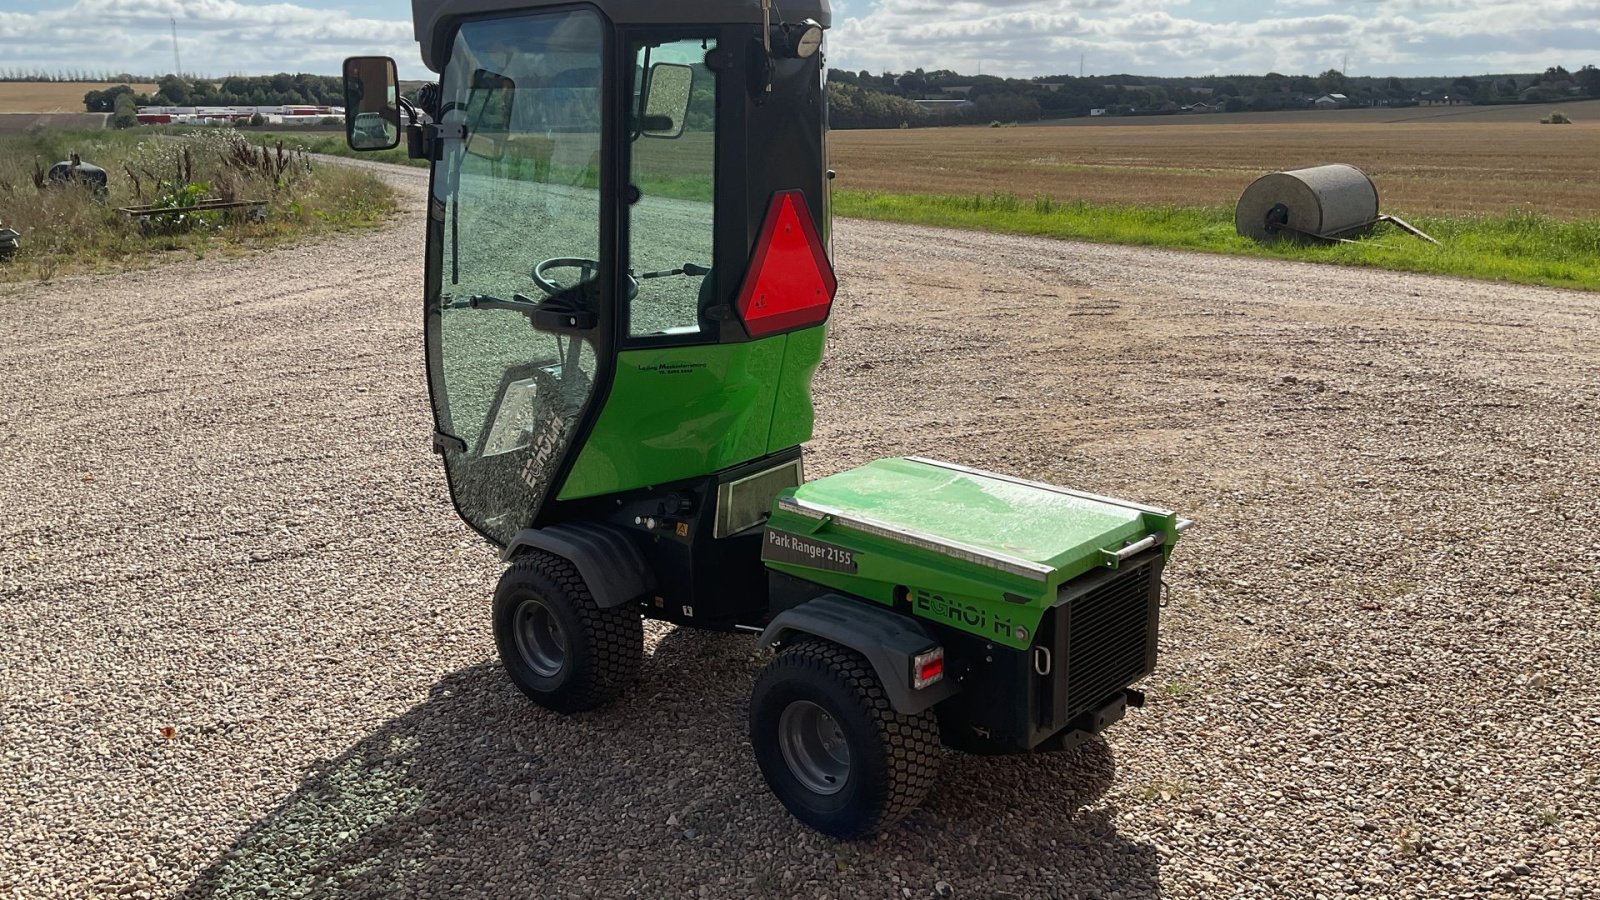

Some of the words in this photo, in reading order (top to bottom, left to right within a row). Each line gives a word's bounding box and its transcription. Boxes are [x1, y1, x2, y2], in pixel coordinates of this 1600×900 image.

[769, 531, 791, 549] Park
[792, 537, 826, 558] Ranger
[827, 547, 851, 565] 2155
